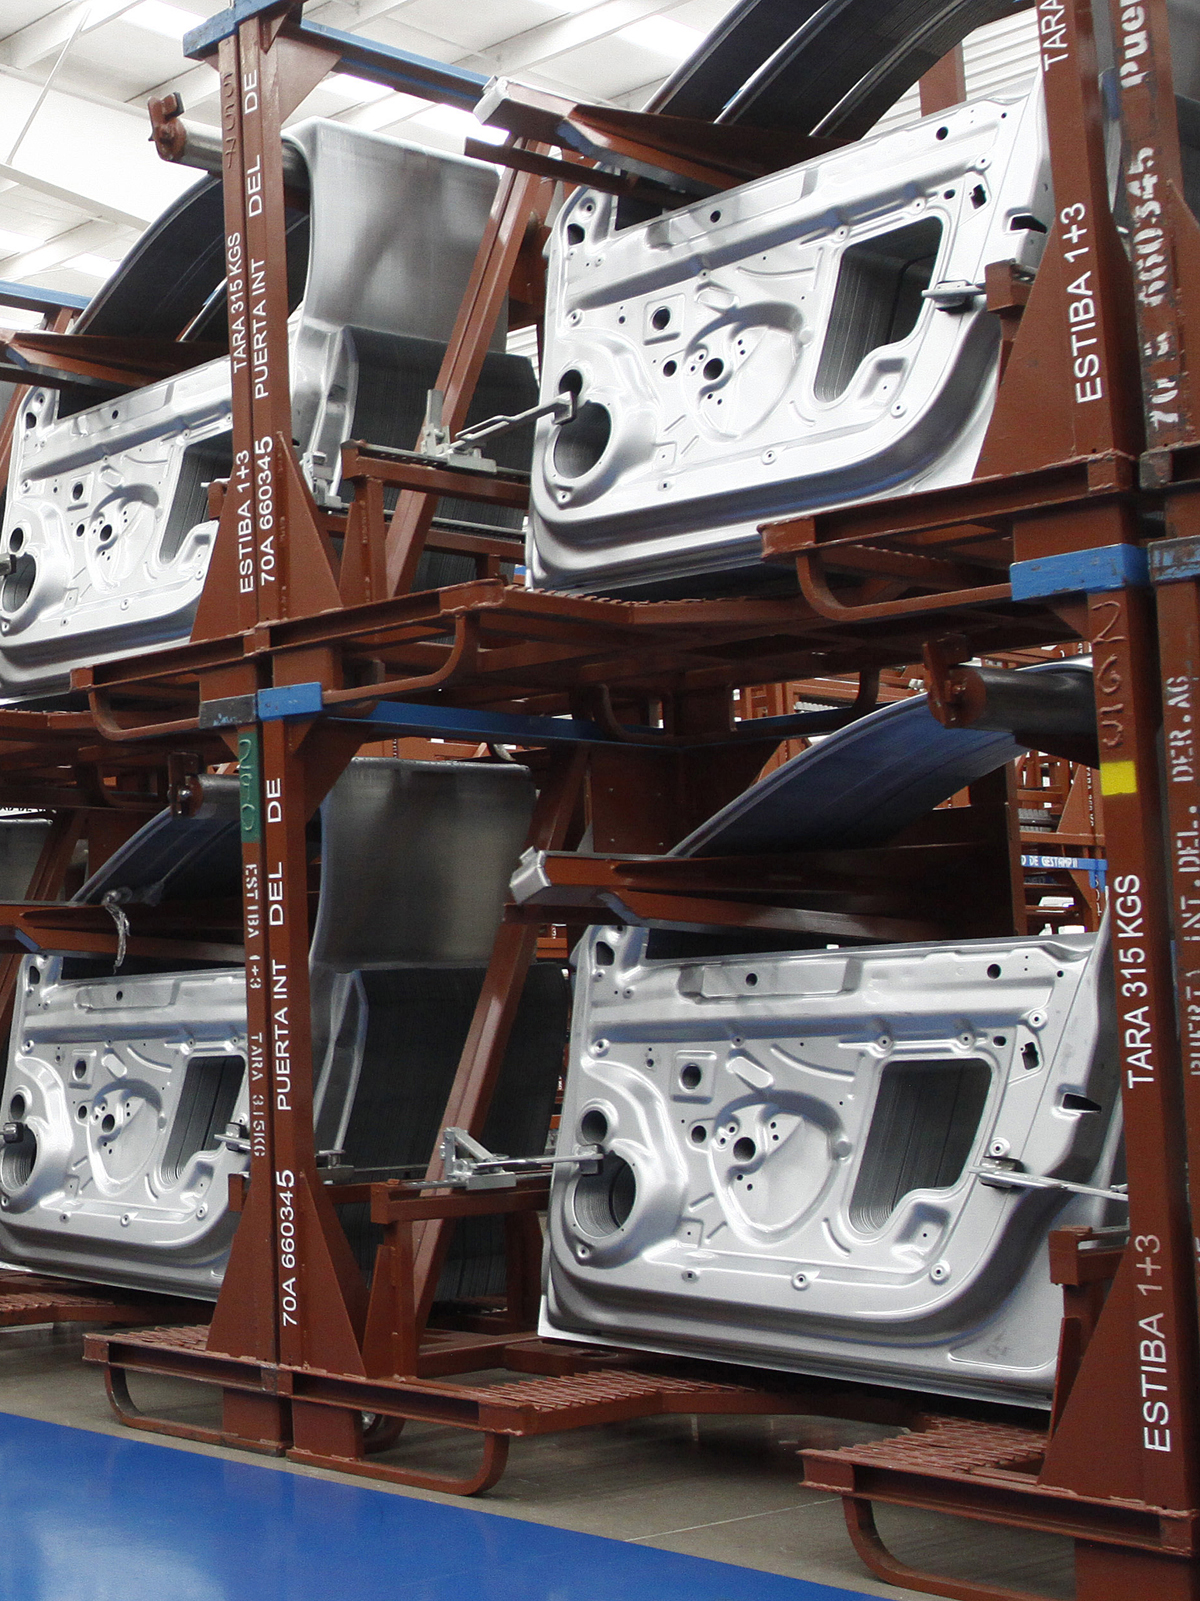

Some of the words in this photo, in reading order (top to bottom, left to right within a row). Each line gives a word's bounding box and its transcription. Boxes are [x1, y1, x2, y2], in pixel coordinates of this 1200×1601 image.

[244, 70, 258, 114] DE
[247, 154, 263, 217] DEL
[227, 232, 242, 277] KGS
[1060, 202, 1090, 263] 1+3
[230, 279, 244, 314] 315
[251, 258, 265, 296] INT
[232, 316, 247, 374] TARA
[253, 299, 269, 399] PUERTA
[1067, 270, 1102, 403] ESTIBA
[236, 450, 250, 493] 1+3
[255, 436, 273, 530] 660345
[237, 499, 254, 593] ESTIBA
[260, 535, 275, 587] 70A
[266, 777, 282, 823] DE
[268, 861, 284, 926] DEL
[1114, 874, 1144, 938] KGS
[272, 959, 287, 999] INT
[1119, 948, 1148, 998] 315
[274, 1006, 291, 1110] PUERTA
[1123, 1005, 1155, 1089] TARA
[276, 1169, 296, 1269] 660345
[1134, 1234, 1163, 1296] 1+3
[282, 1277, 298, 1327] 70A
[1138, 1312, 1171, 1452] ESTIBA
